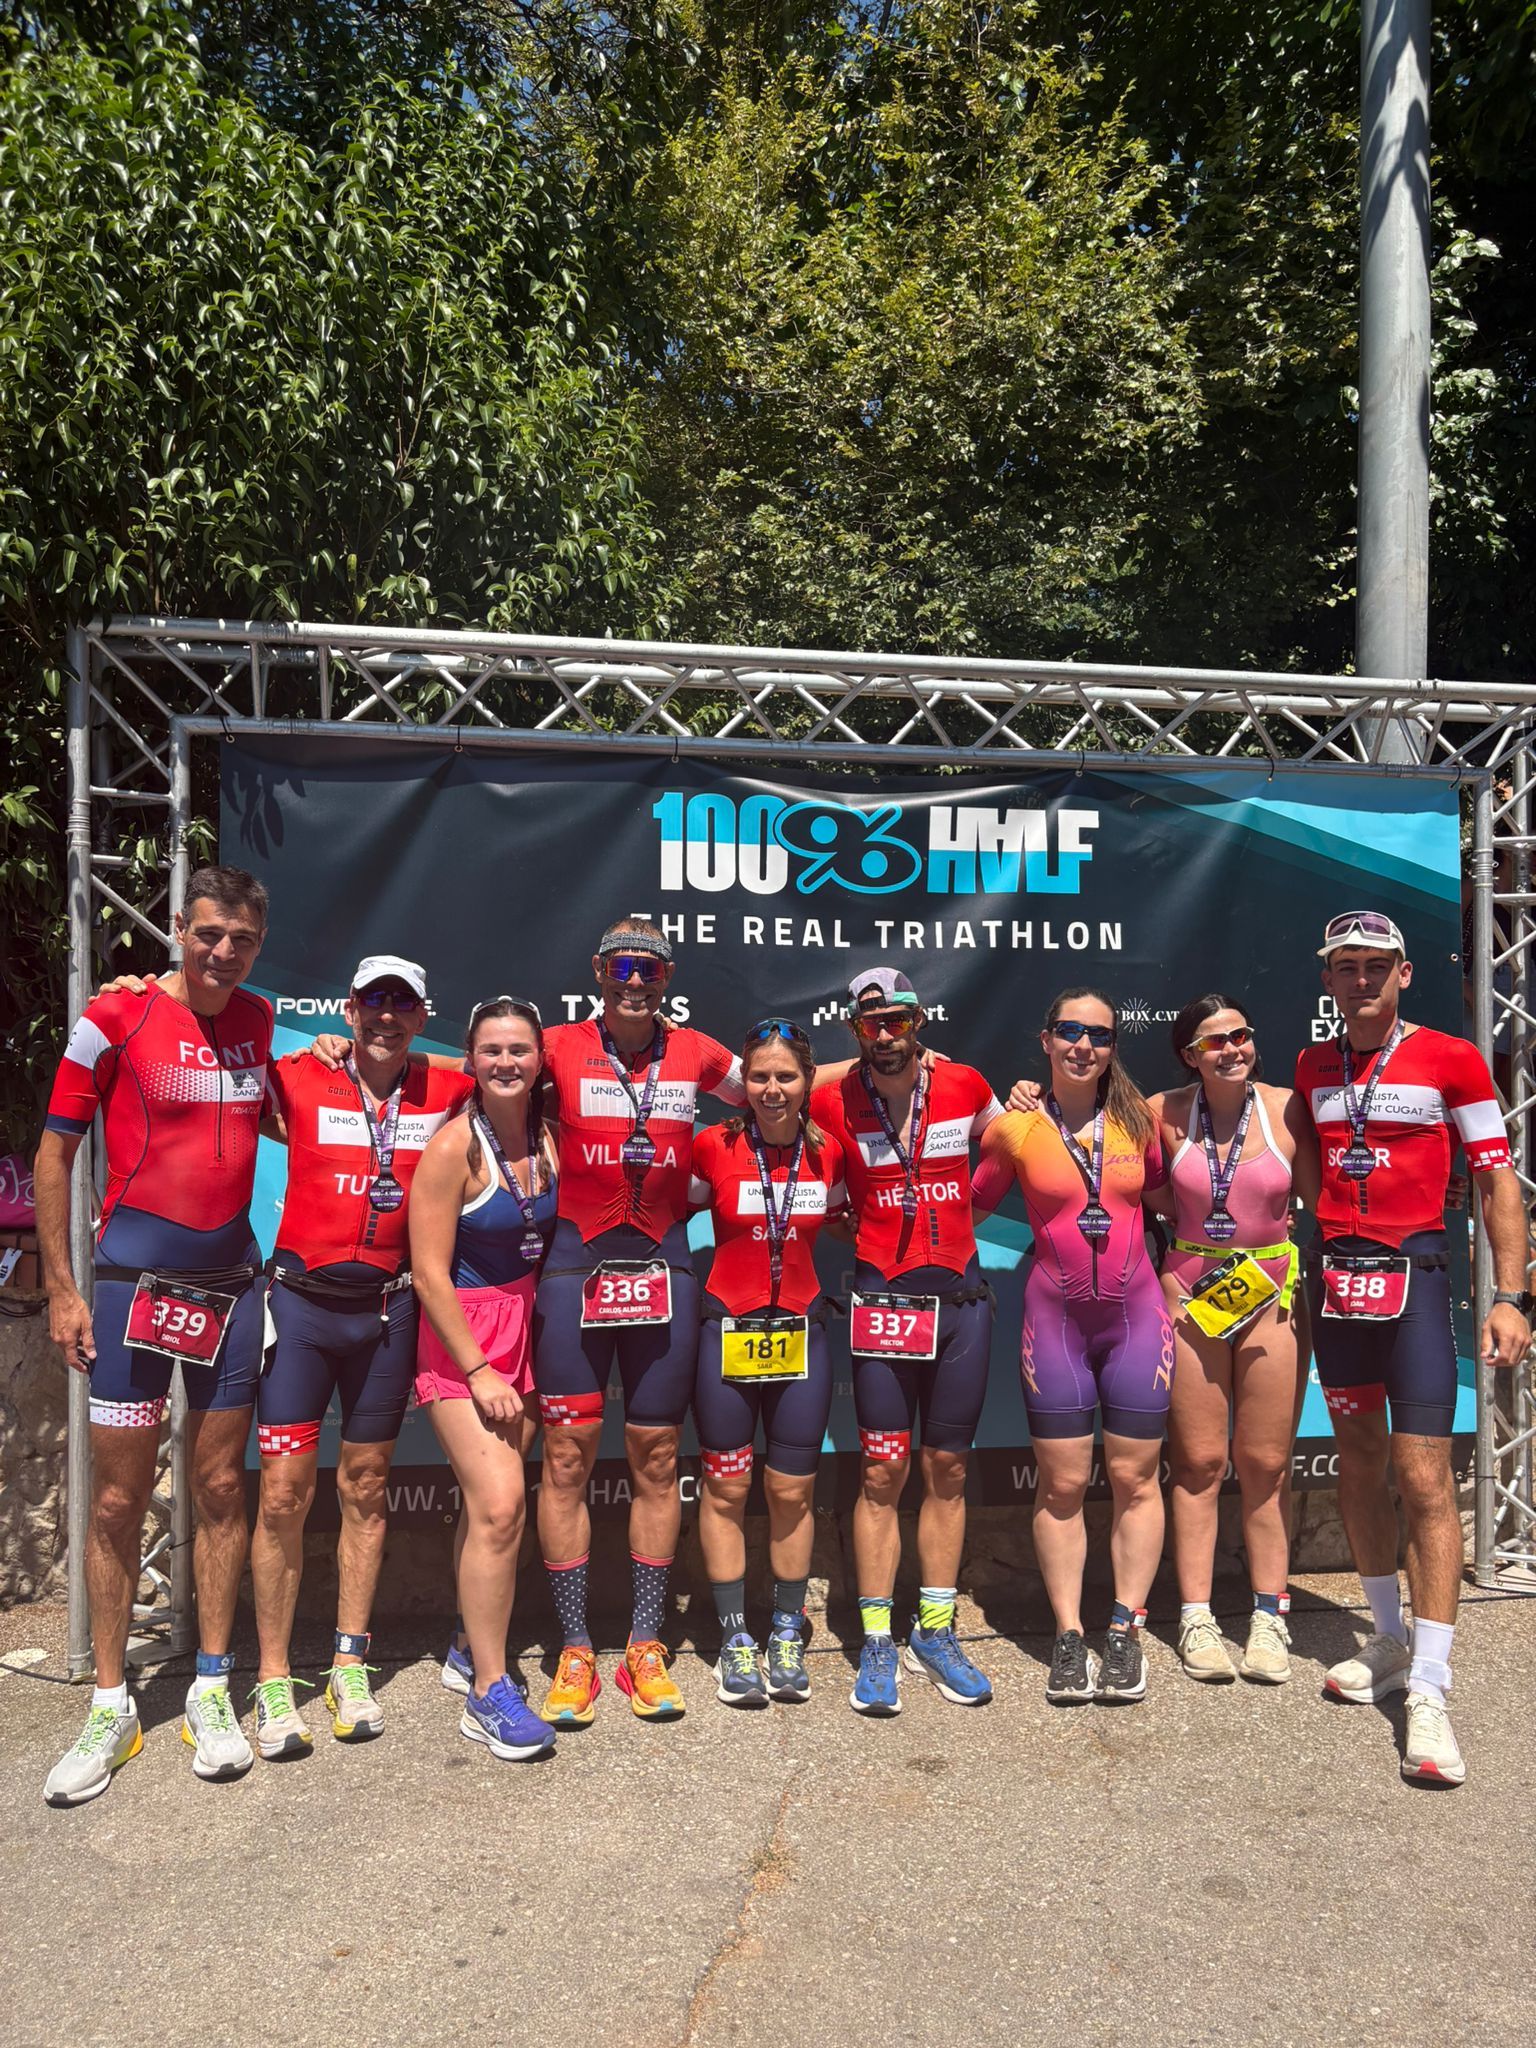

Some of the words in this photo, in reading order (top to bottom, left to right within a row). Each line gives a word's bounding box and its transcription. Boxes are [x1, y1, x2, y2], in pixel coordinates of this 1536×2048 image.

[630, 913, 716, 943] HE
[743, 915, 851, 948] REAL
[873, 919, 1123, 950] TRIATHLON
[179, 1040, 255, 1068] FONT
[591, 1085, 625, 1098] UNIÓ
[328, 1114, 360, 1126] UNIÓ
[1384, 1105, 1424, 1116] CUGAT
[929, 1140, 951, 1151] SANT
[930, 1128, 962, 1140] CICLISTA
[600, 1279, 651, 1304] 336
[1207, 1276, 1250, 1311] 179
[1336, 1275, 1387, 1299] 338
[151, 1301, 207, 1337] 339
[599, 1306, 621, 1314] CARLOS
[622, 1305, 652, 1313] ALBERTO
[868, 1312, 918, 1337] 337
[743, 1337, 787, 1360] 181
[880, 1338, 904, 1347] HECTOR
